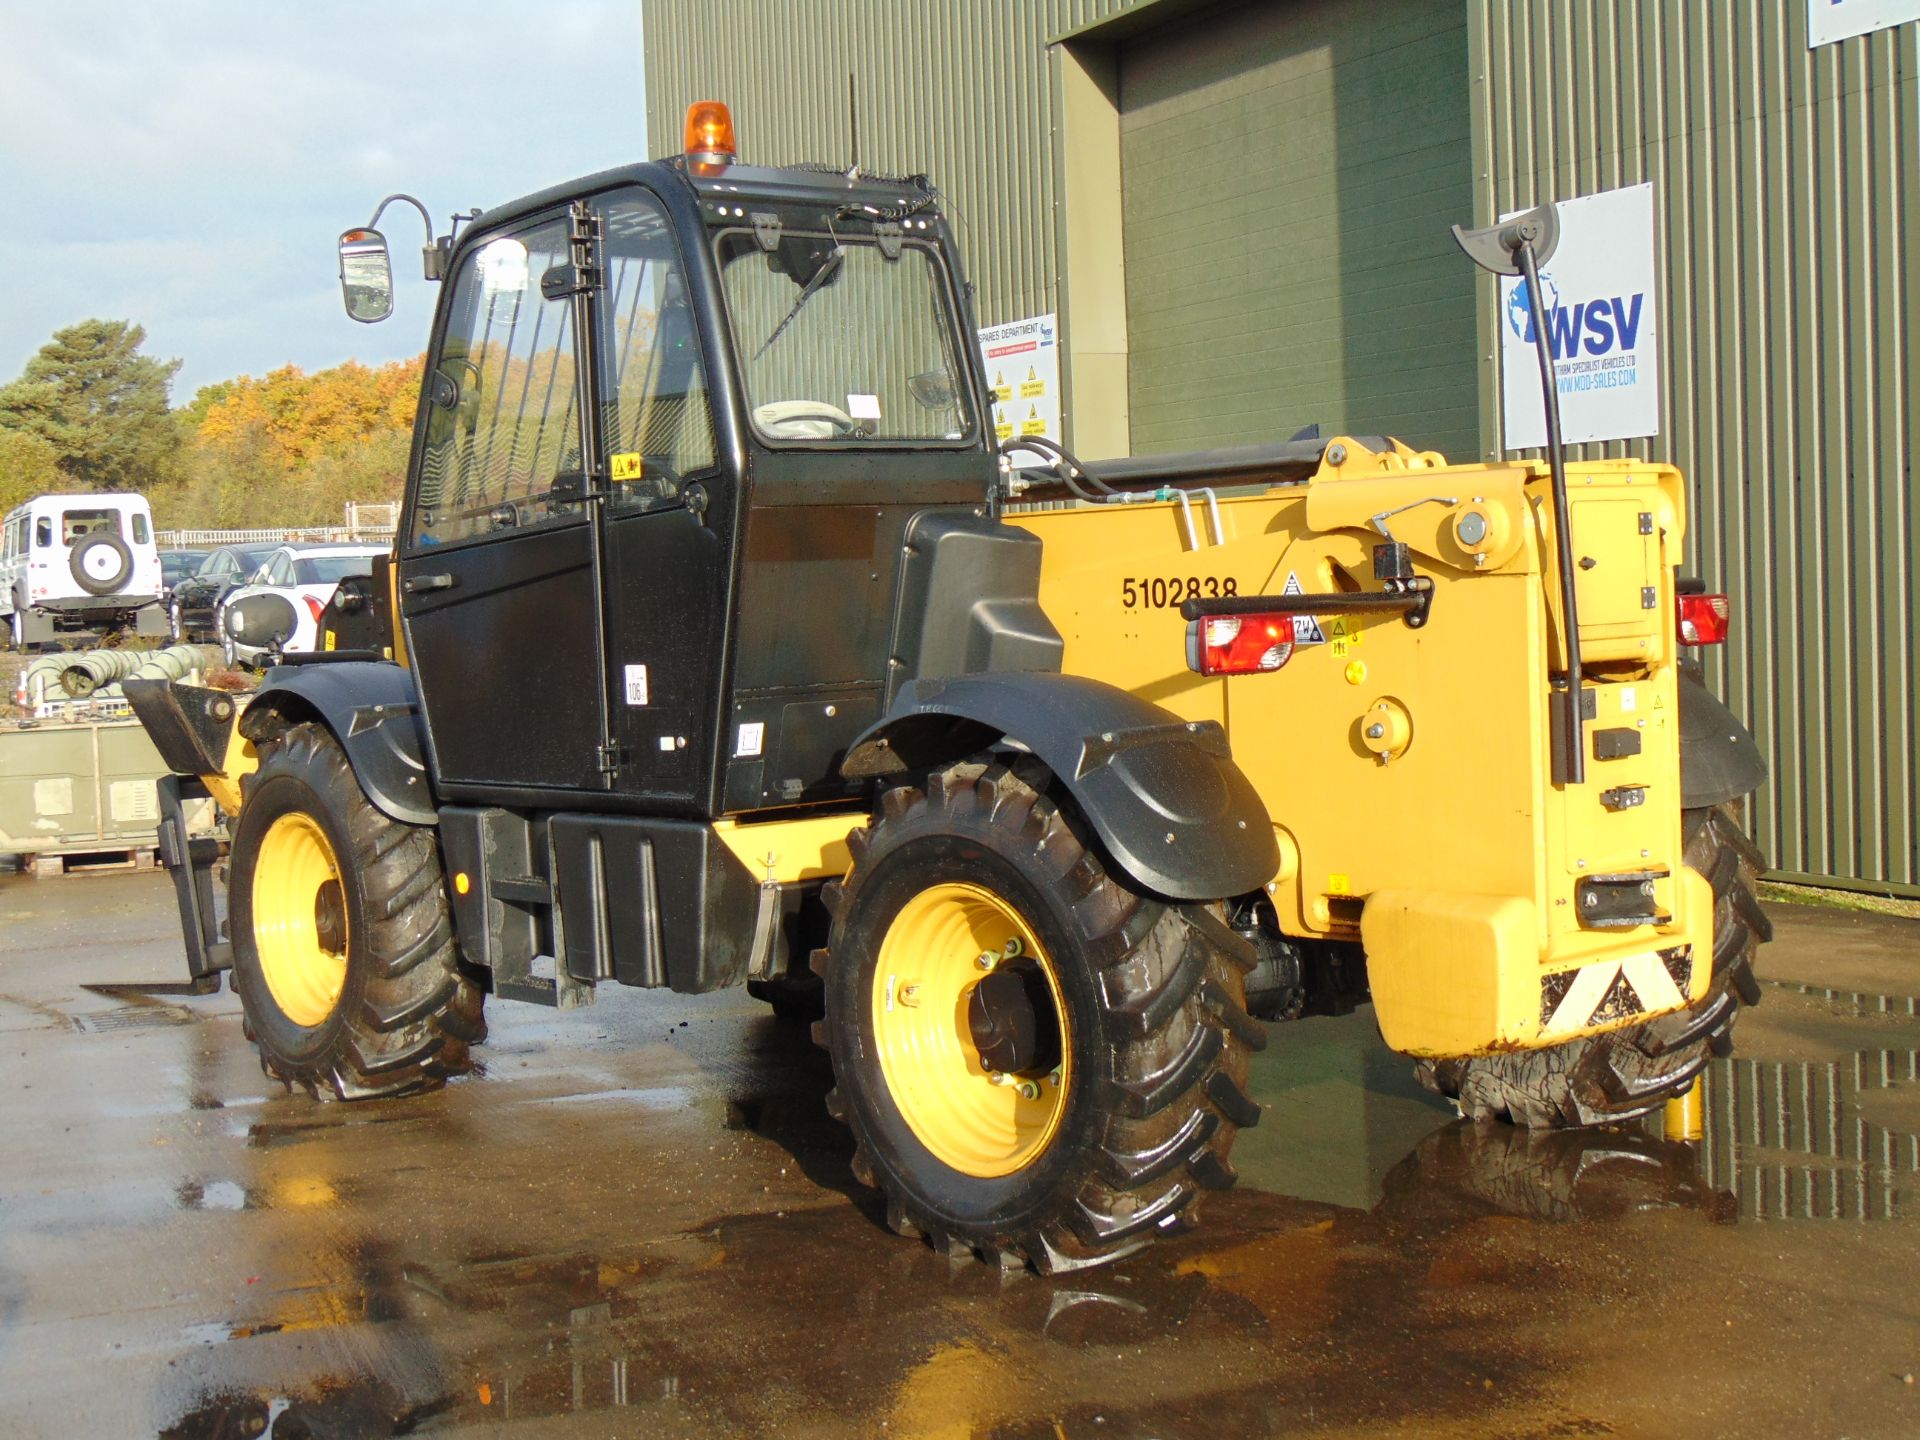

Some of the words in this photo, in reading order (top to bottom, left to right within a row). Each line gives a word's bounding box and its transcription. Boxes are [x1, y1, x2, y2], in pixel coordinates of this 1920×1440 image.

[979, 330, 999, 344] SPARES
[1001, 322, 1038, 339] DEPARTMENT
[1545, 293, 1643, 361] WSV
[1572, 360, 1600, 374] SPECIALIST
[1601, 356, 1625, 370] VEHICLES
[1626, 355, 1636, 367] LTD
[1122, 577, 1238, 609] 5102838
